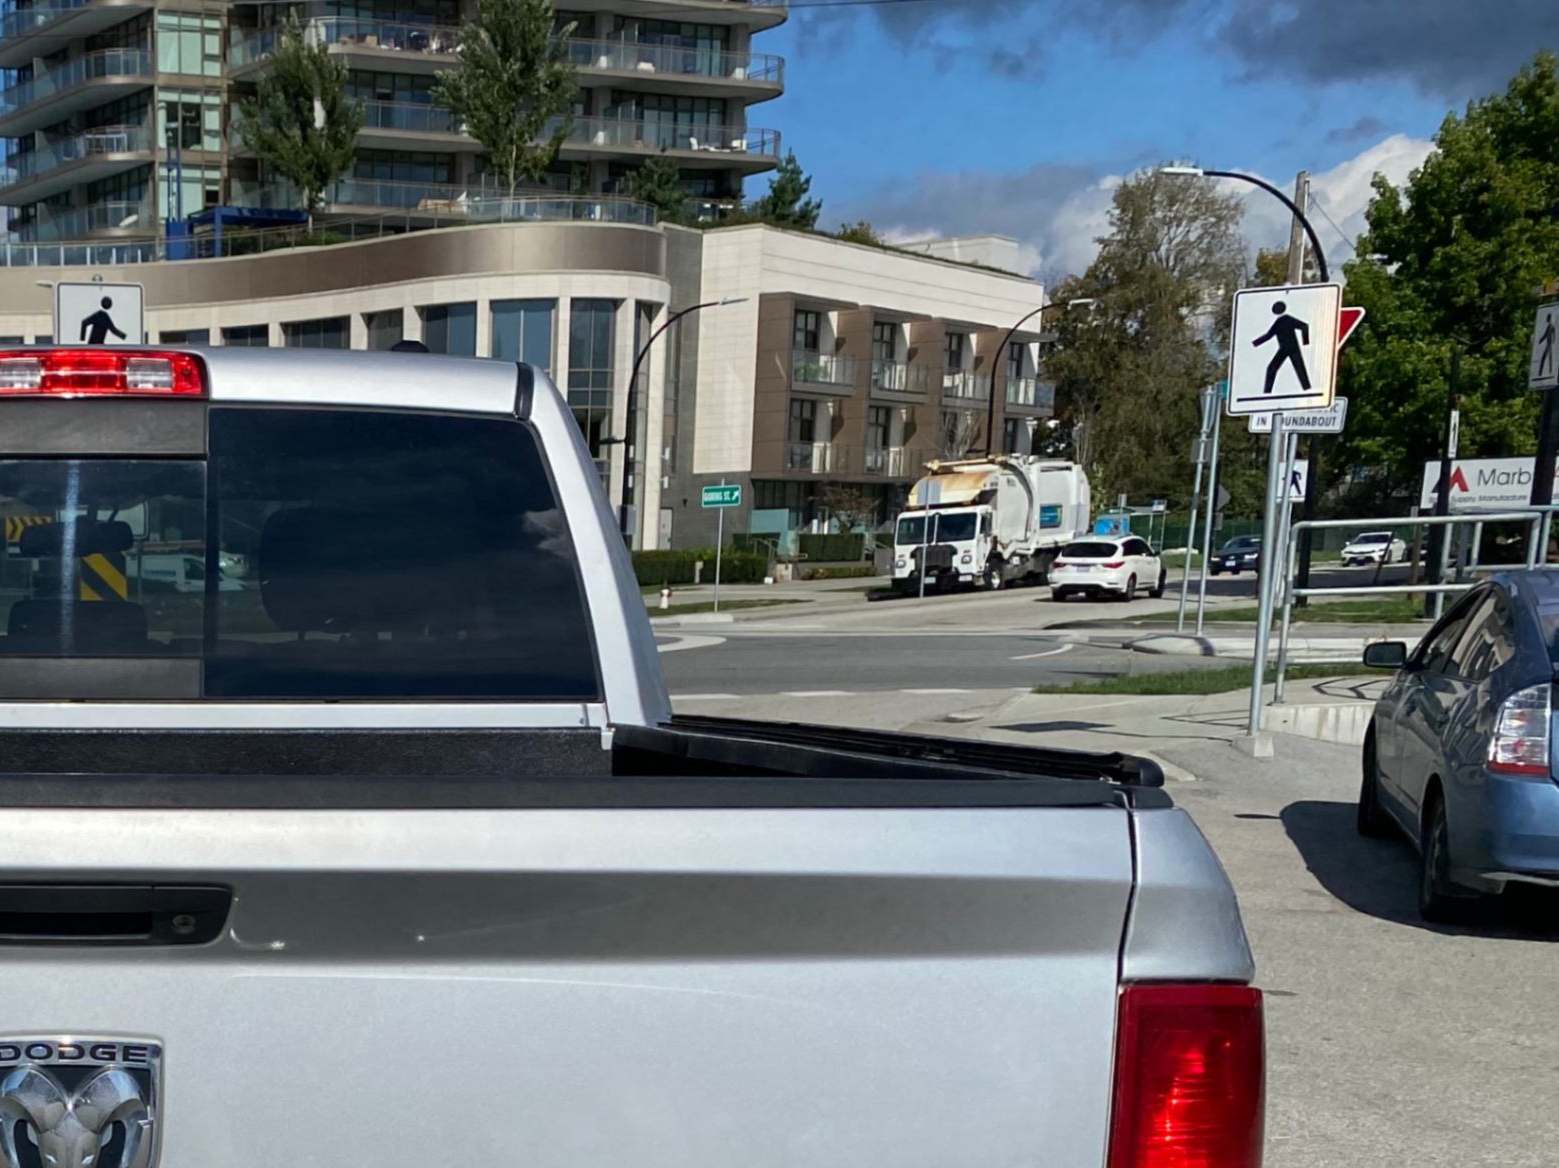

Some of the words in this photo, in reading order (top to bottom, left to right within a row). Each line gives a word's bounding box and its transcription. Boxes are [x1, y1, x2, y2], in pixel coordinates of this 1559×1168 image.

[1256, 417, 1267, 426] IN
[1281, 416, 1337, 427] UNDABOUT
[1477, 468, 1532, 486] Marb
